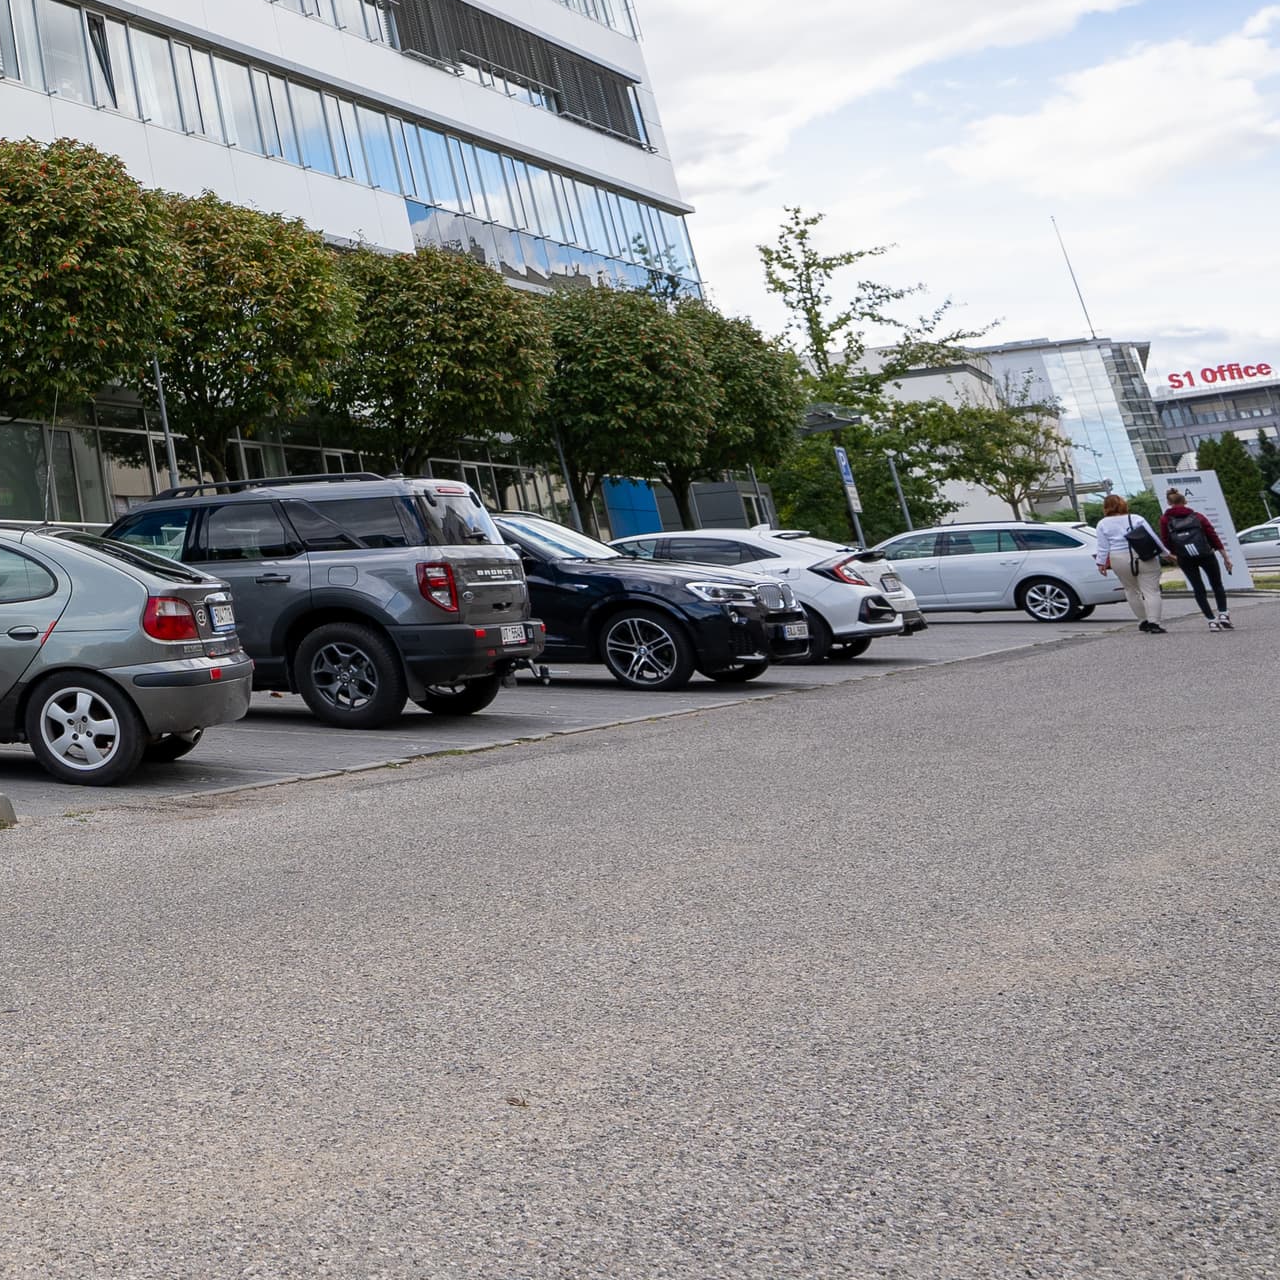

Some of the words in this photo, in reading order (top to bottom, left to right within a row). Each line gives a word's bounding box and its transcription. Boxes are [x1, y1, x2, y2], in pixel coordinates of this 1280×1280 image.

[1168, 371, 1195, 389] S1
[1200, 362, 1272, 384] Office
[1184, 488, 1194, 496] A
